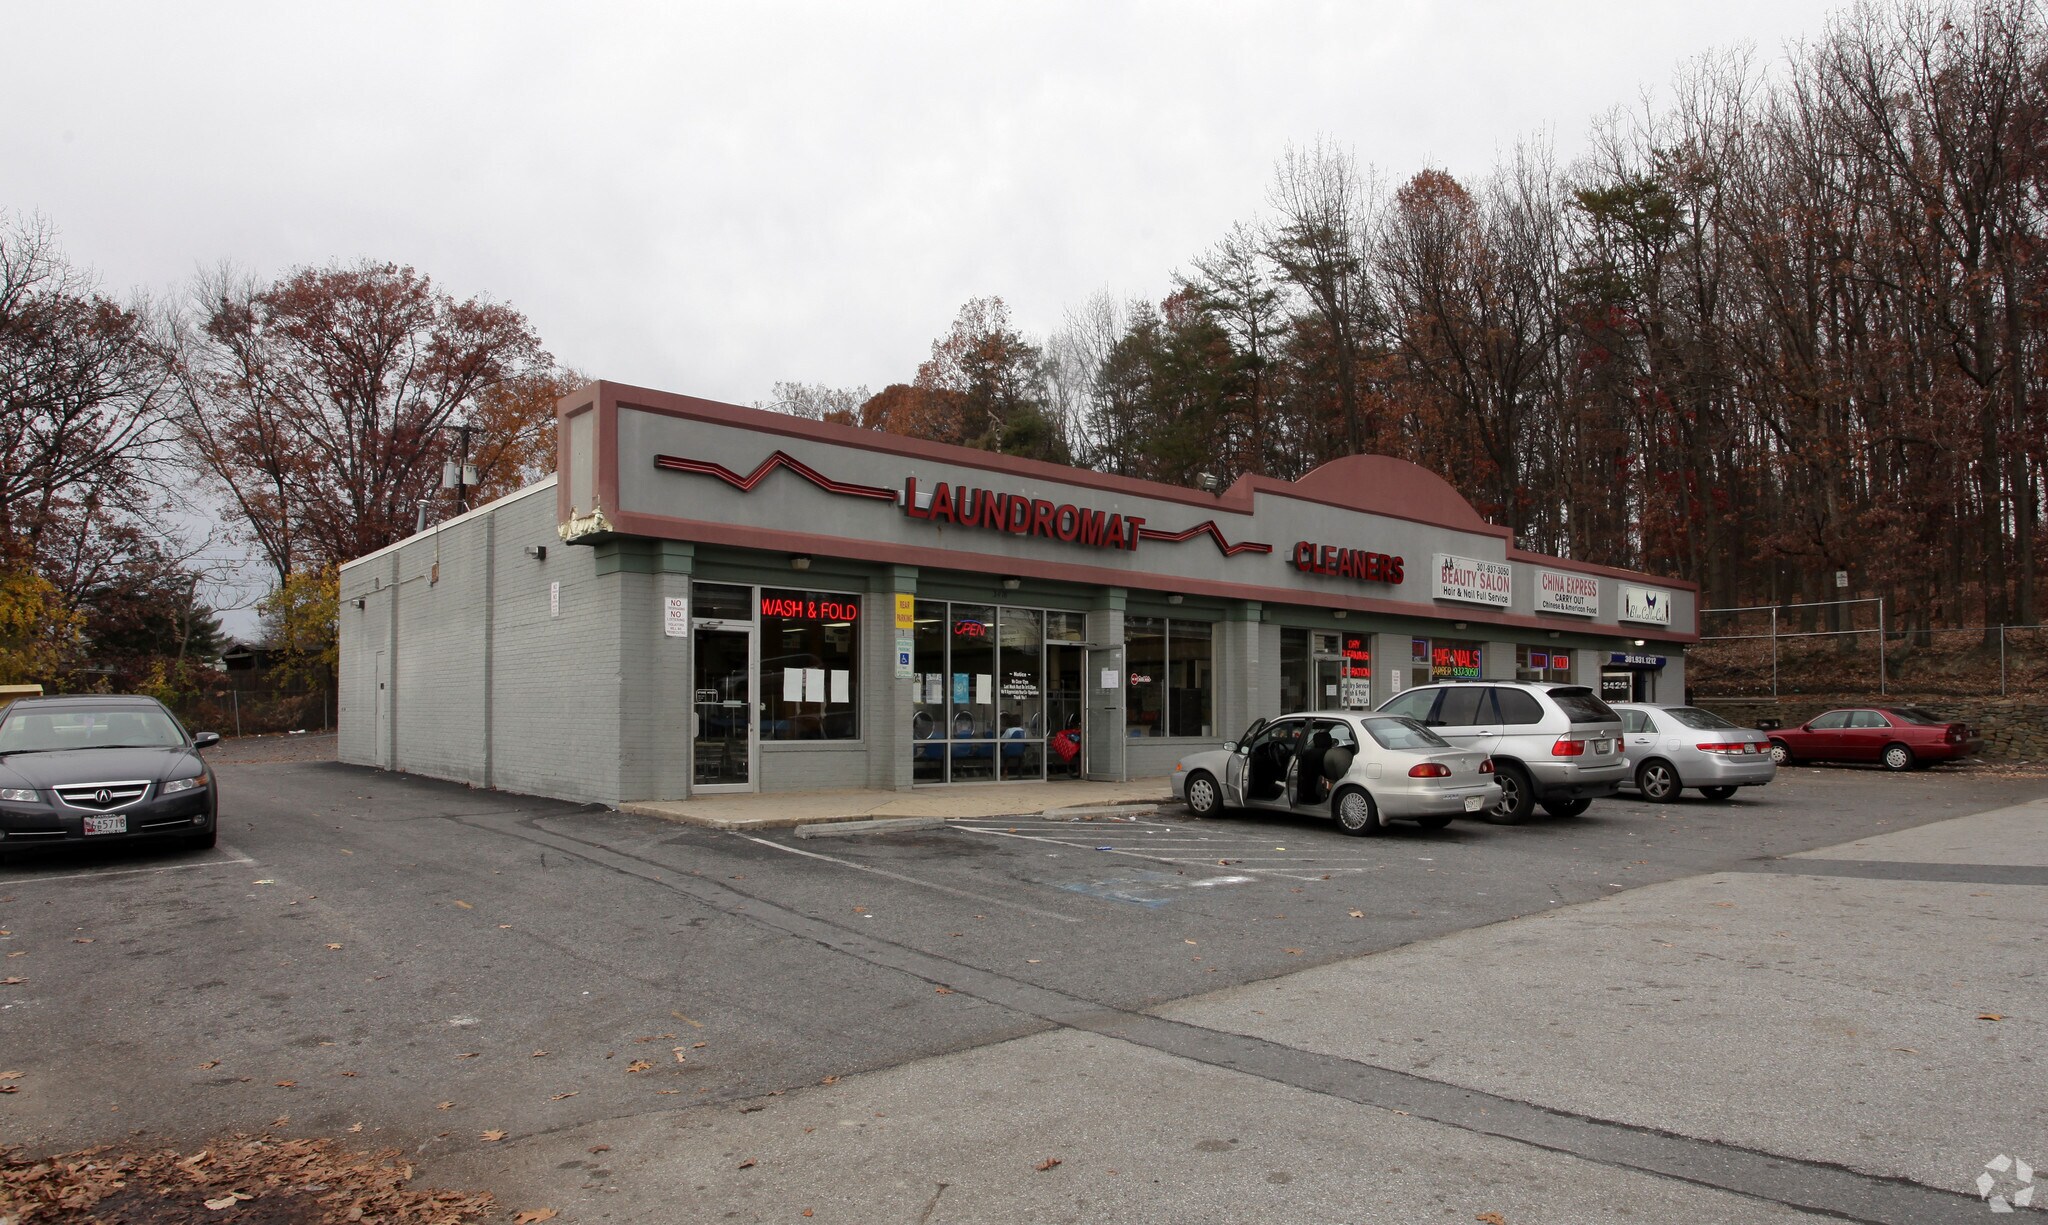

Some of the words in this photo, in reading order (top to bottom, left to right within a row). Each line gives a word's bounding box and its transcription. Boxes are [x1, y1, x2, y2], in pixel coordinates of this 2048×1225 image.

[904, 477, 1146, 551] LAUNDROMAT
[1293, 541, 1404, 584] CLEANERS
[1441, 566, 1476, 588] BEAUTY
[1480, 572, 1509, 593] SALON
[1542, 574, 1564, 592] CHINA
[1567, 577, 1597, 597] EXPRESS
[1443, 586, 1456, 596] Hair
[1457, 588, 1462, 597] &
[1464, 589, 1475, 599] Nail
[1477, 591, 1487, 600] Full
[1488, 593, 1508, 603] Service
[1555, 593, 1572, 603] CARRY
[1573, 596, 1584, 605] OUT
[761, 598, 803, 618] WASH
[808, 601, 817, 618] &
[821, 602, 857, 620] FOLD
[1543, 600, 1560, 610] Chinese
[1565, 604, 1586, 613] American
[1586, 606, 1597, 614] Food
[954, 621, 986, 636] OPEN
[1348, 640, 1360, 648] DRY
